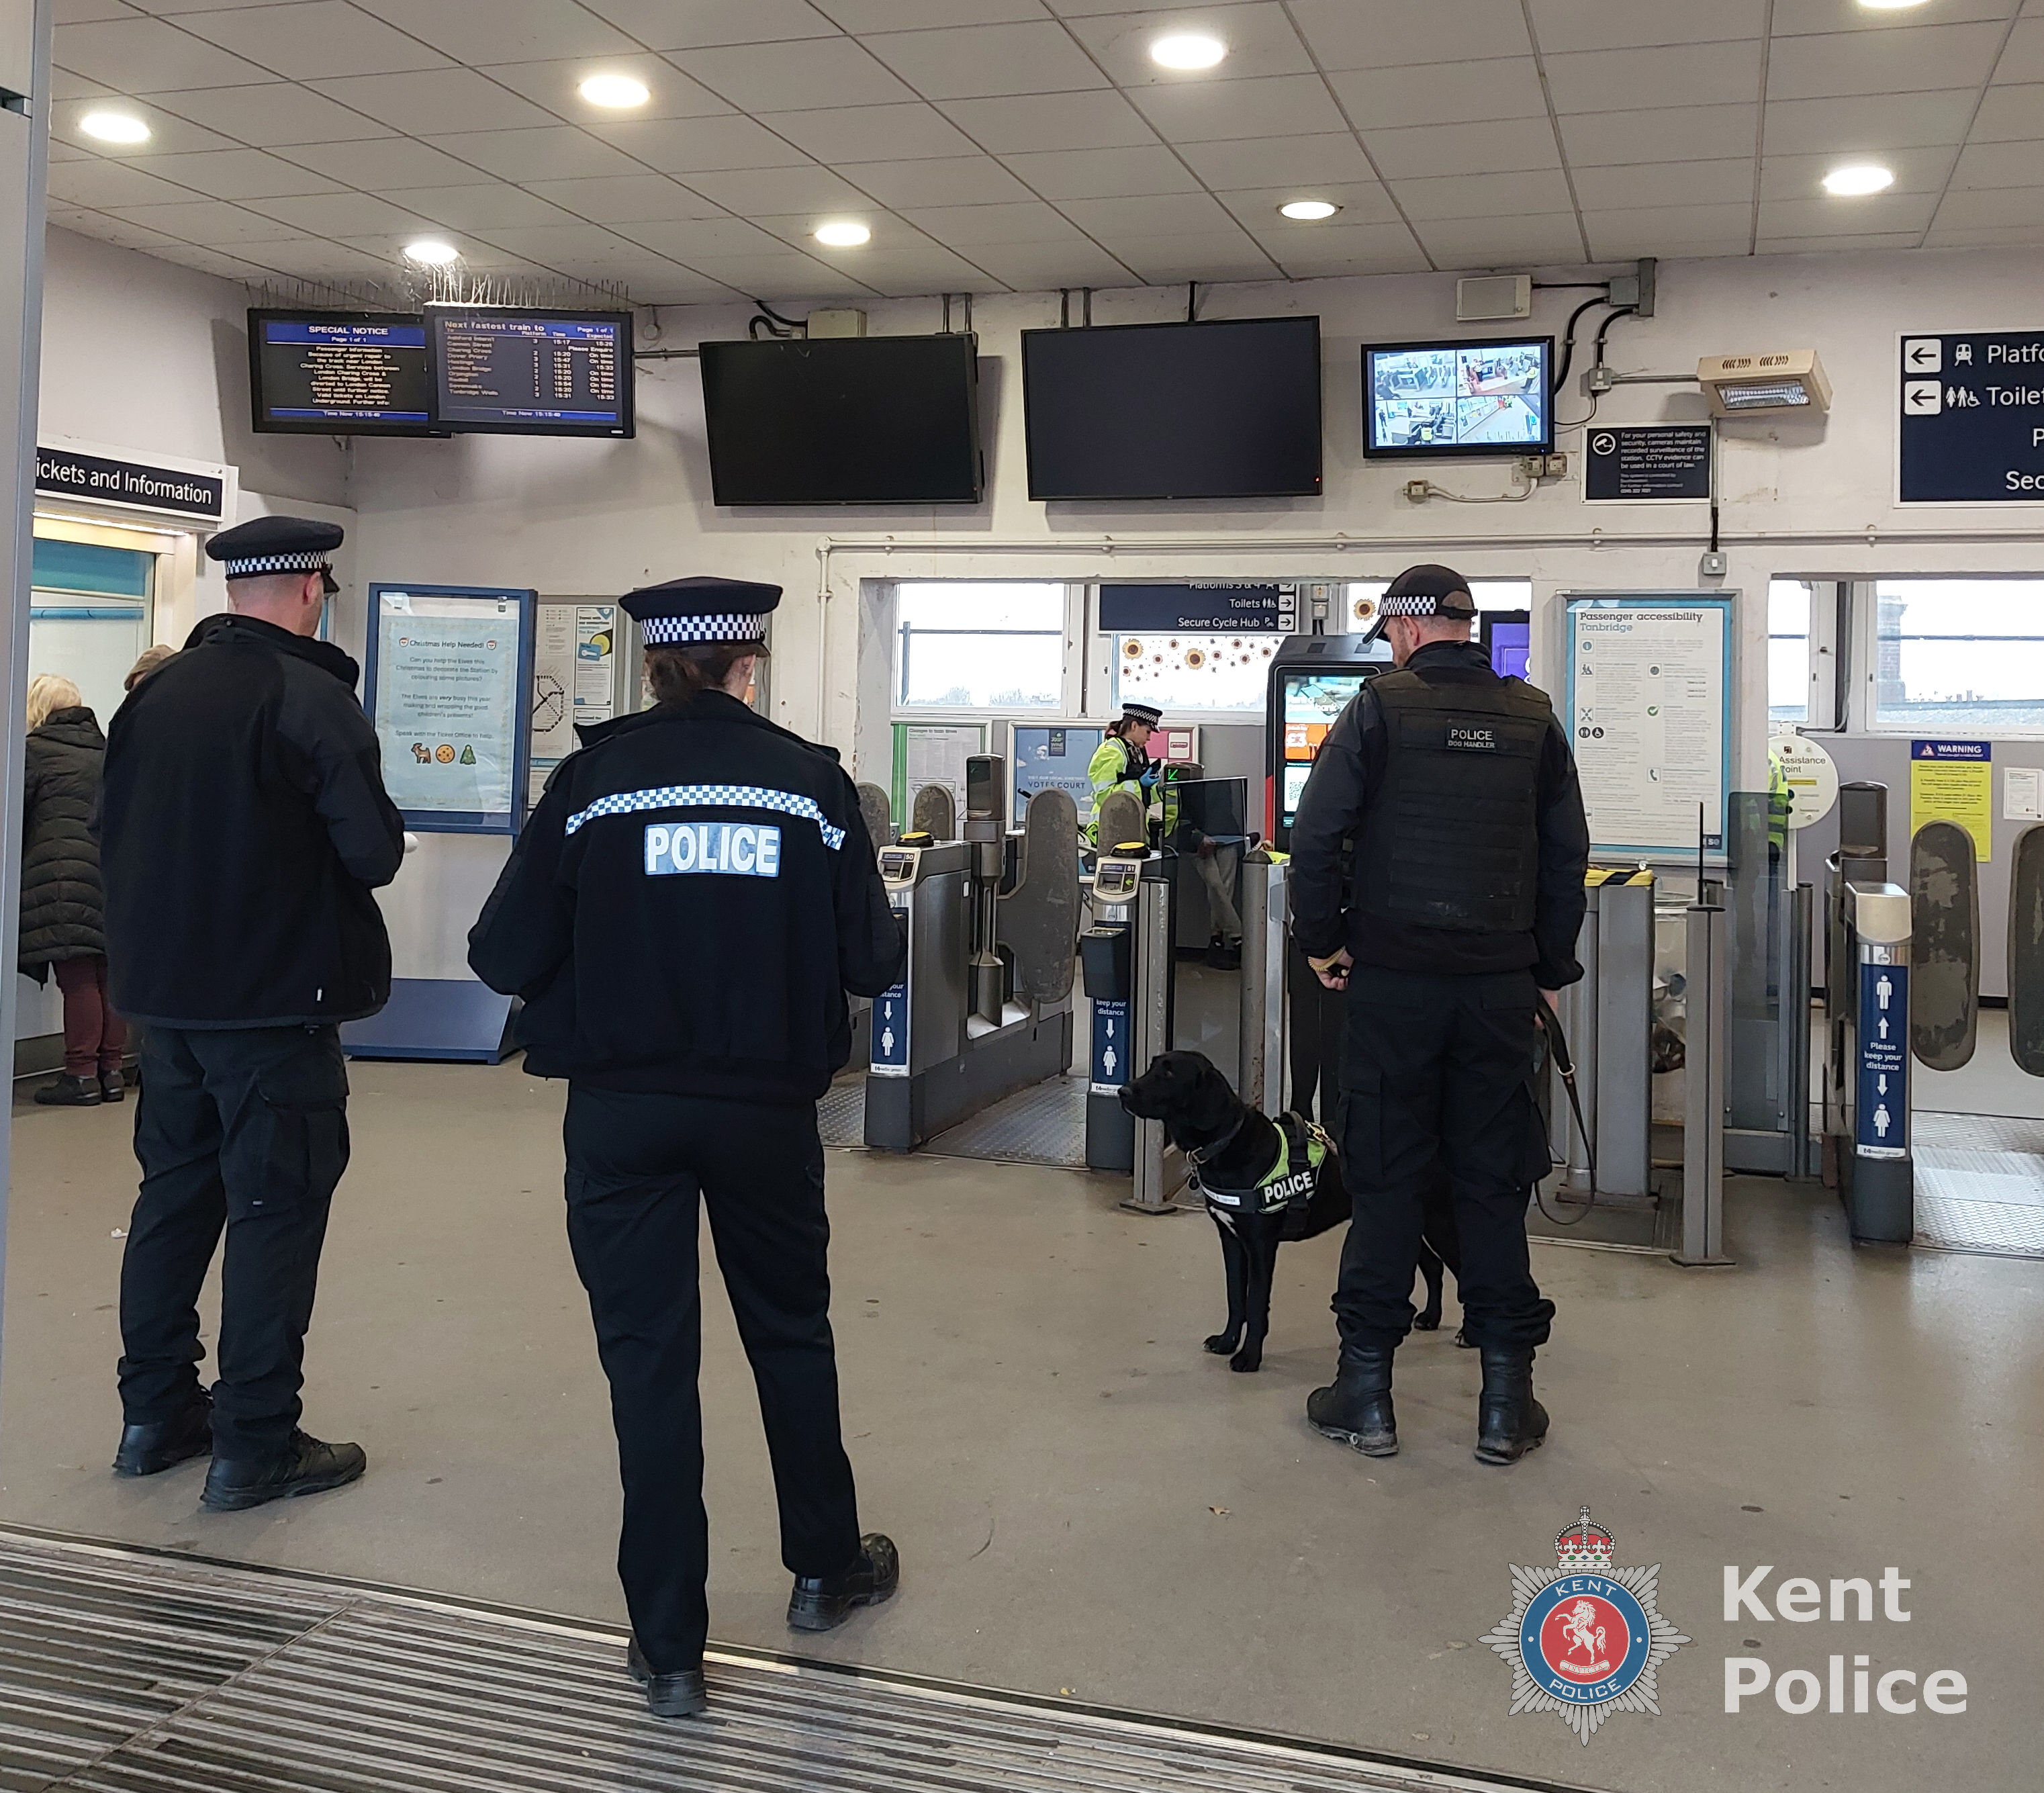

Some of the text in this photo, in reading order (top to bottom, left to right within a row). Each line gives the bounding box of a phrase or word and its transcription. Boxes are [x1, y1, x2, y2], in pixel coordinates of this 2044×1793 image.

[36, 457, 212, 505] ickets and Information
[2005, 470, 2044, 491] Sec
[1229, 598, 1261, 609] Toilets
[1580, 612, 1703, 623] Passenger accessibility
[1178, 616, 1260, 630] Secure Cycle Hub
[1580, 623, 1633, 633] Tonbridge
[410, 640, 440, 648] Christmas
[442, 641, 456, 649] Help
[1451, 729, 1493, 741] POLICE
[1463, 741, 1495, 749] HANDLER
[1937, 744, 1983, 754] WARNING
[1779, 756, 1826, 764] Assistance
[647, 825, 779, 874] POLICE
[1111, 1001, 1127, 1009] your
[1097, 1007, 1125, 1016] distance
[1870, 1042, 1897, 1051] Please
[1864, 1050, 1903, 1062] keep your
[1865, 1061, 1900, 1071] distance
[1264, 1170, 1313, 1203] POLICE
